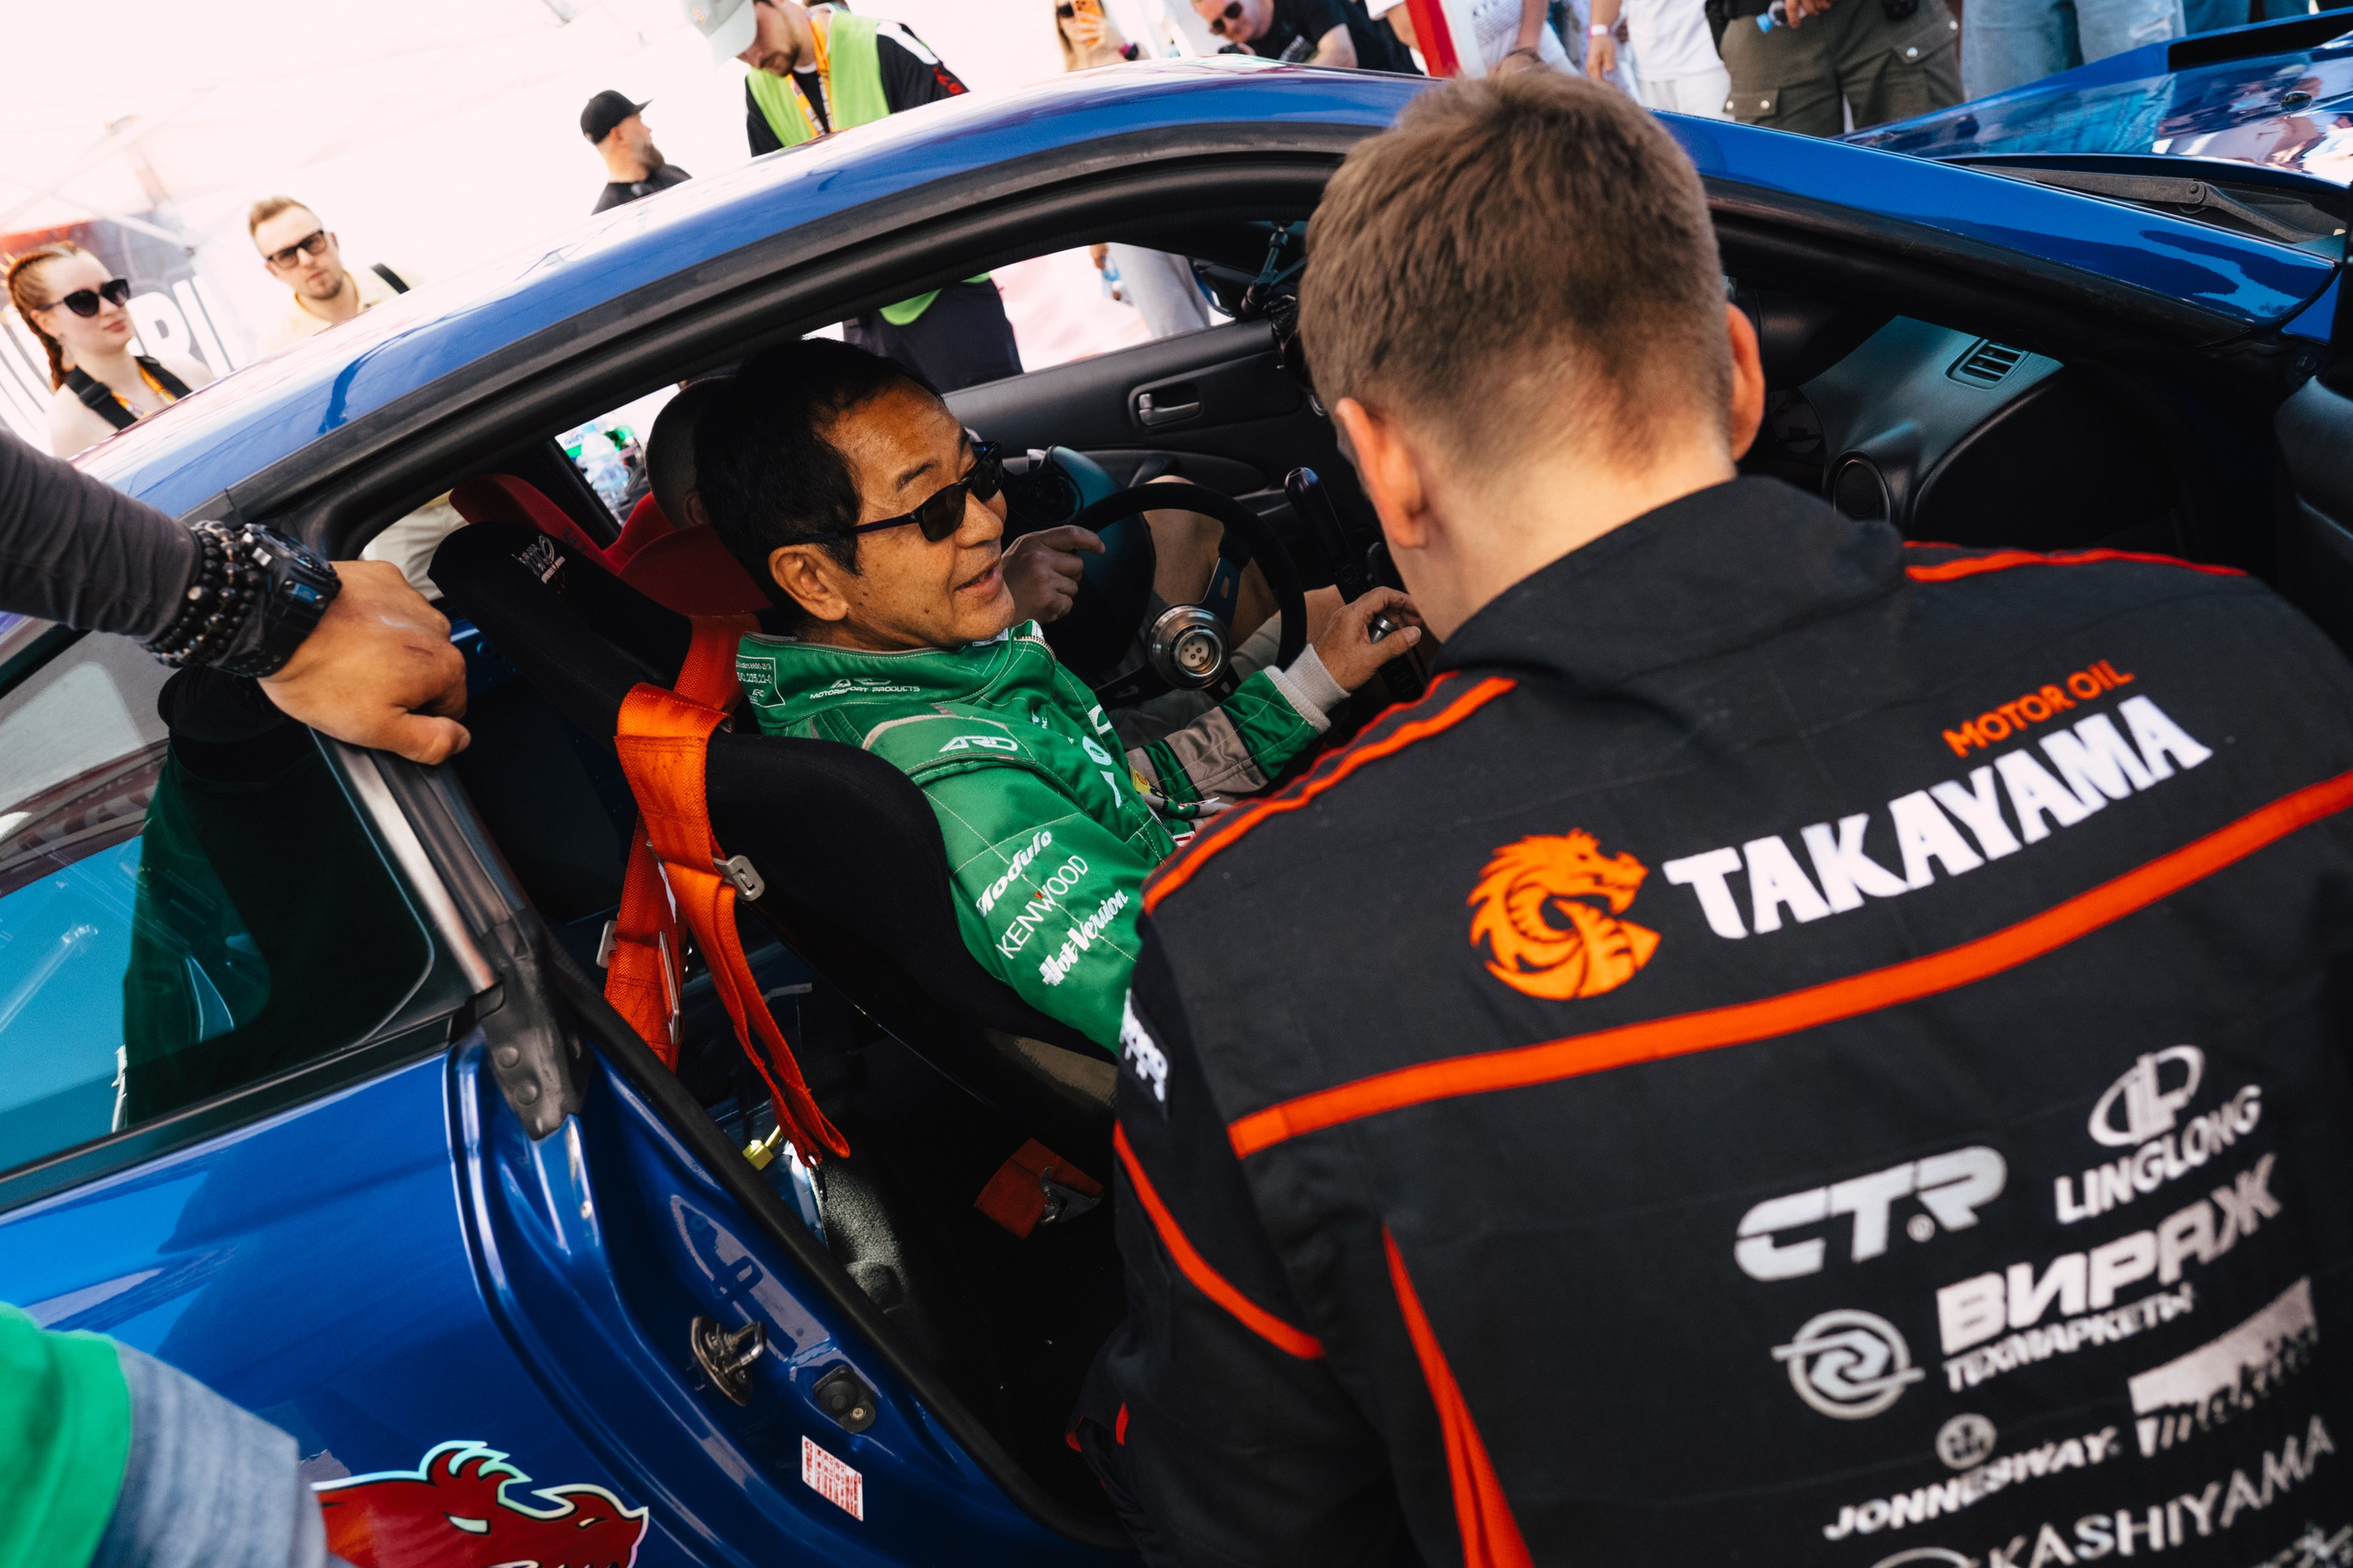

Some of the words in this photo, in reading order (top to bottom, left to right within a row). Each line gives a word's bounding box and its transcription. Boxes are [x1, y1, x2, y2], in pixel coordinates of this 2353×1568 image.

[810, 687, 869, 699] MOTORSPORT
[938, 735, 1018, 753] ARD
[1941, 683, 2078, 758] MOTOR
[2066, 659, 2136, 701] OIL
[1662, 694, 2213, 939] TAKAYAMA
[995, 855, 1088, 960] KENWOOD
[2054, 1085, 2262, 1225] LINGLONG
[1734, 1145, 2007, 1281] CTR
[1936, 1153, 2281, 1356] ВИРАЖ
[1823, 1426, 2118, 1540] JONNESWAY
